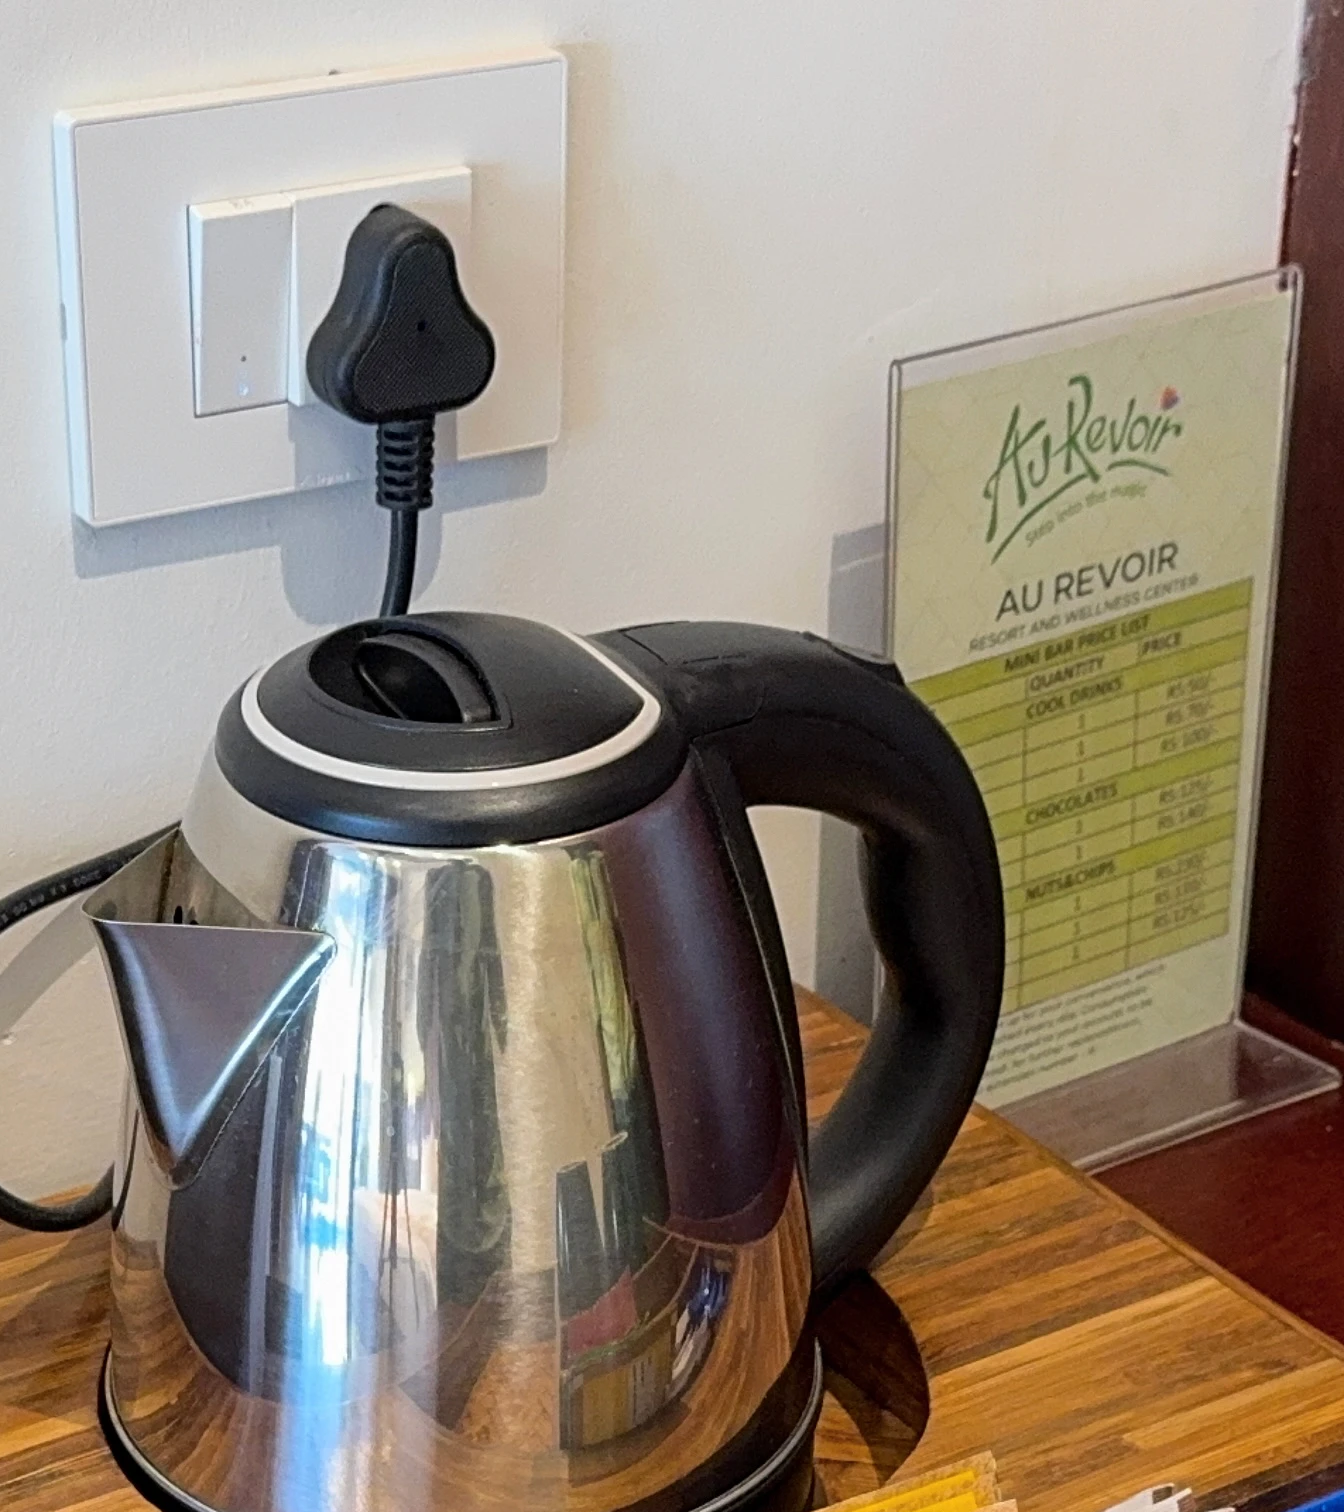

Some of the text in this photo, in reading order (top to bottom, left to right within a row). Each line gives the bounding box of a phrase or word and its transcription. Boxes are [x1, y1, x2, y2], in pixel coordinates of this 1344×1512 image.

[995, 541, 1179, 622] AU REVOIR
[968, 623, 1026, 653] RESORT
[1030, 614, 1061, 635] AND
[1065, 590, 1141, 624] WELLNESS
[1004, 613, 1152, 673] MINI BAR PRICE LIST
[1140, 631, 1183, 656] PRICE
[1029, 656, 1105, 692] QUANTITY
[1069, 675, 1124, 706] DRINKS
[1025, 782, 1118, 825] CHOCOLATES
